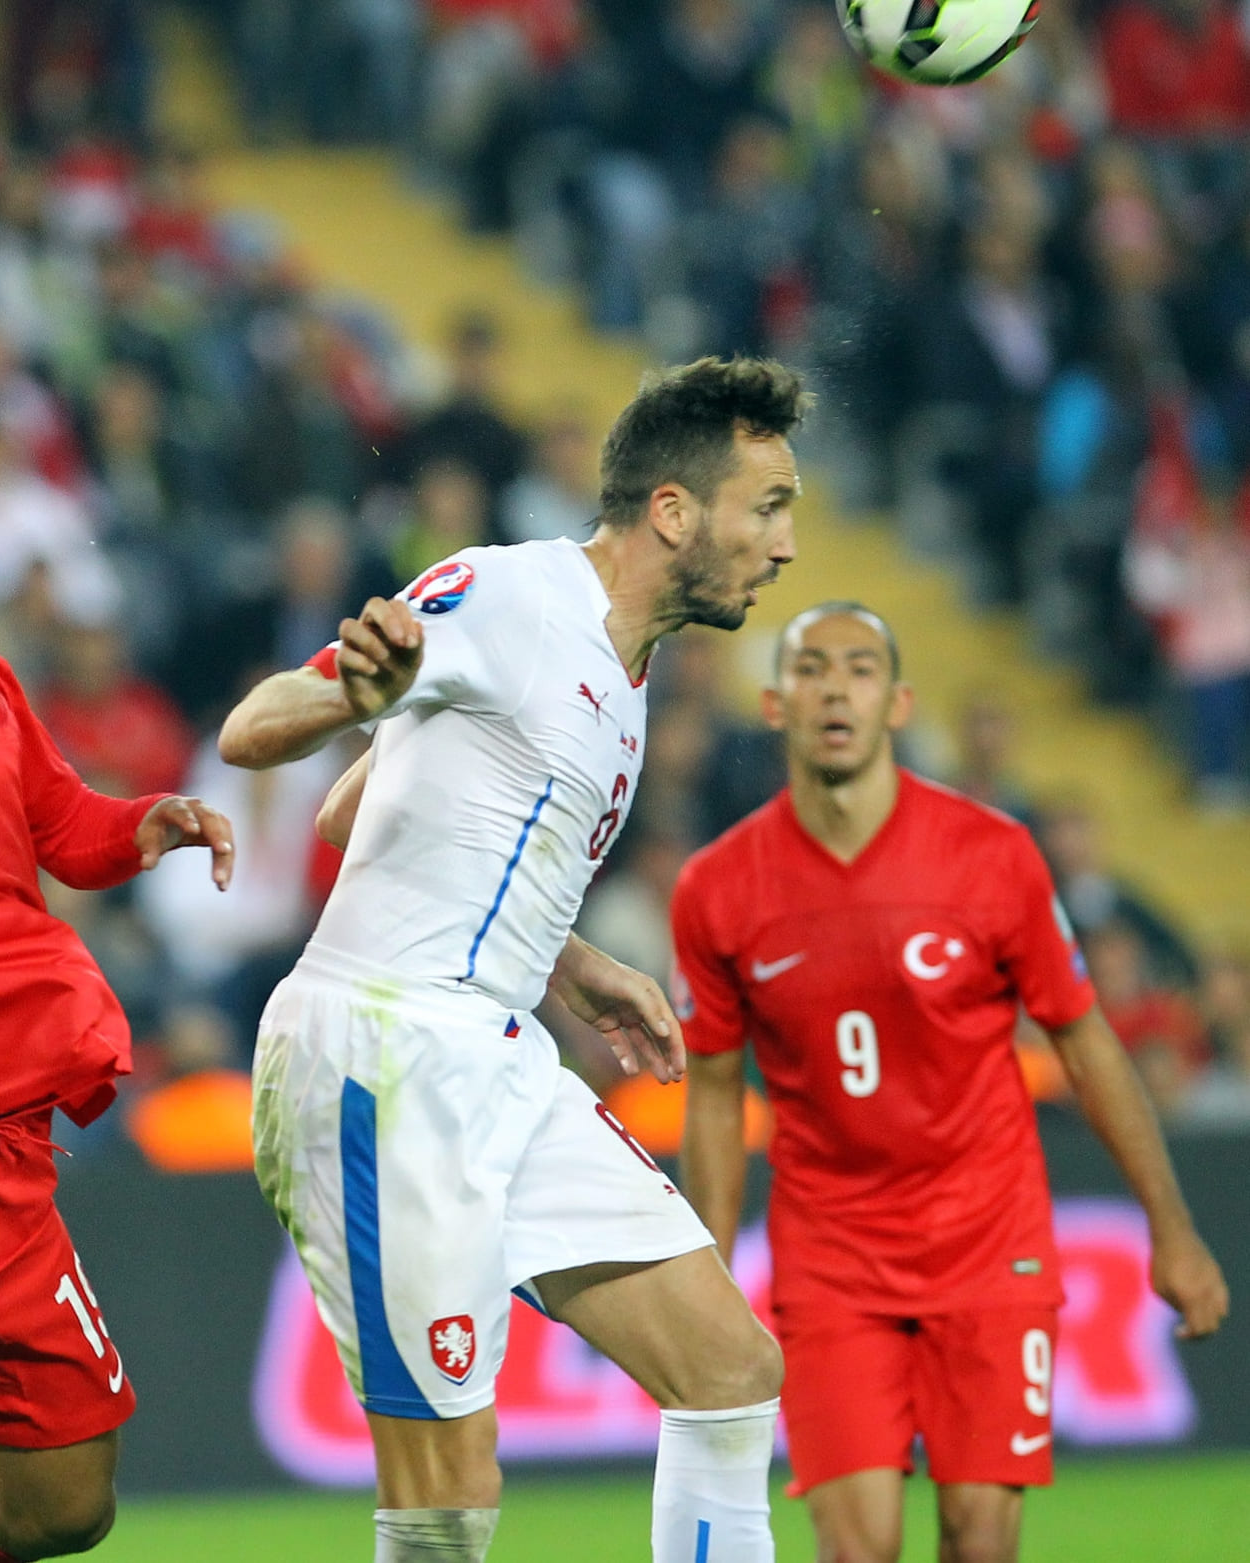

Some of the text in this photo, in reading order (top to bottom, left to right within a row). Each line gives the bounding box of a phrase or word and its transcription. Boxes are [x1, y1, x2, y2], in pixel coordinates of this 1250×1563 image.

[590, 773, 628, 861] 6
[836, 1010, 880, 1098] 9
[1022, 1328, 1051, 1416] 9
